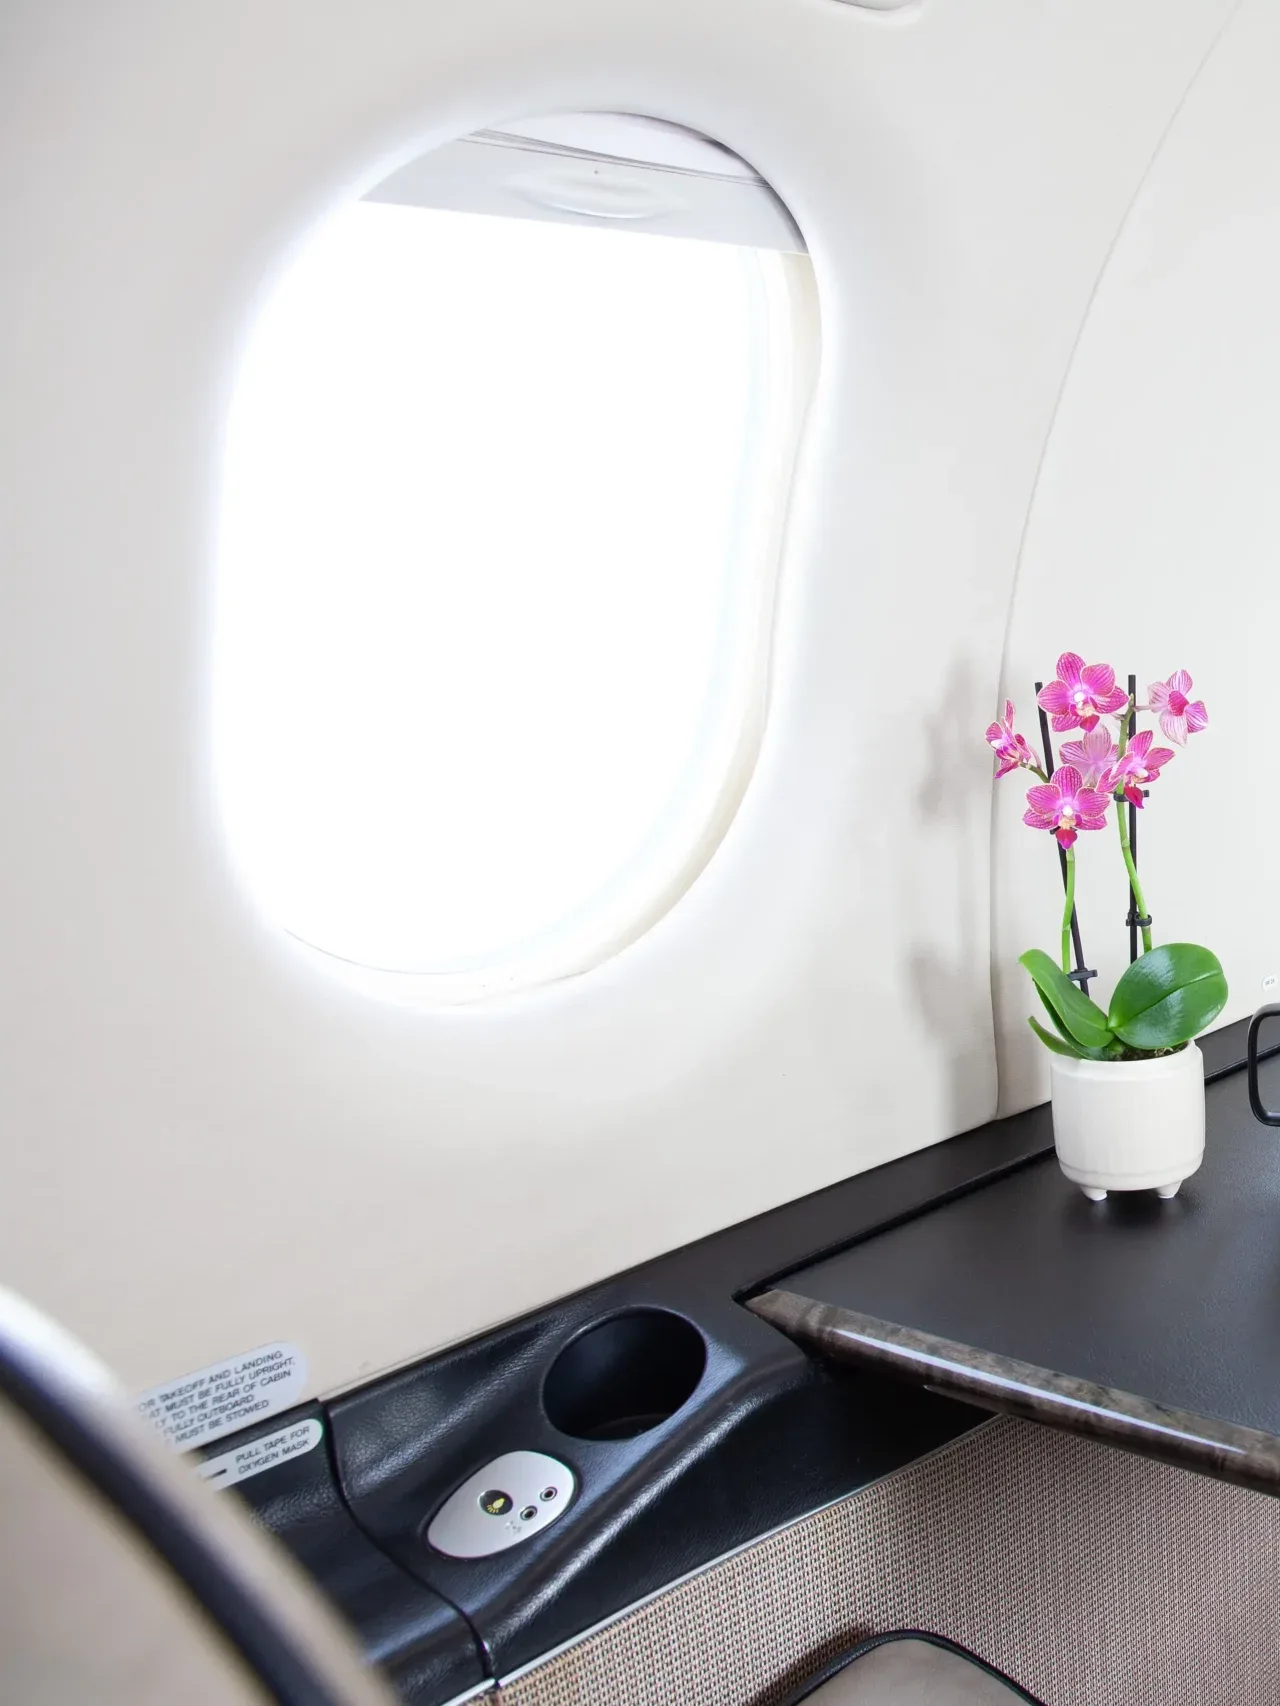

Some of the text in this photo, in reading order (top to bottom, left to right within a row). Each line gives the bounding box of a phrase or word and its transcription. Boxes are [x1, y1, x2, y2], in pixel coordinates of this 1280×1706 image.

[139, 1350, 283, 1412] OR TAKEOFF AND LANDING
[165, 1394, 195, 1412] MUST
[198, 1387, 213, 1400] BE
[215, 1374, 245, 1393] FULLY
[172, 1369, 291, 1421] TO THE REAR OF CABIN
[175, 1424, 205, 1444] MUST
[208, 1417, 223, 1430] BE
[226, 1399, 270, 1422] STOWED
[197, 1394, 255, 1423] OUTBOARD
[235, 1425, 310, 1463] PULL TAPE FOR
[238, 1438, 310, 1474] OXYGEN MASK
